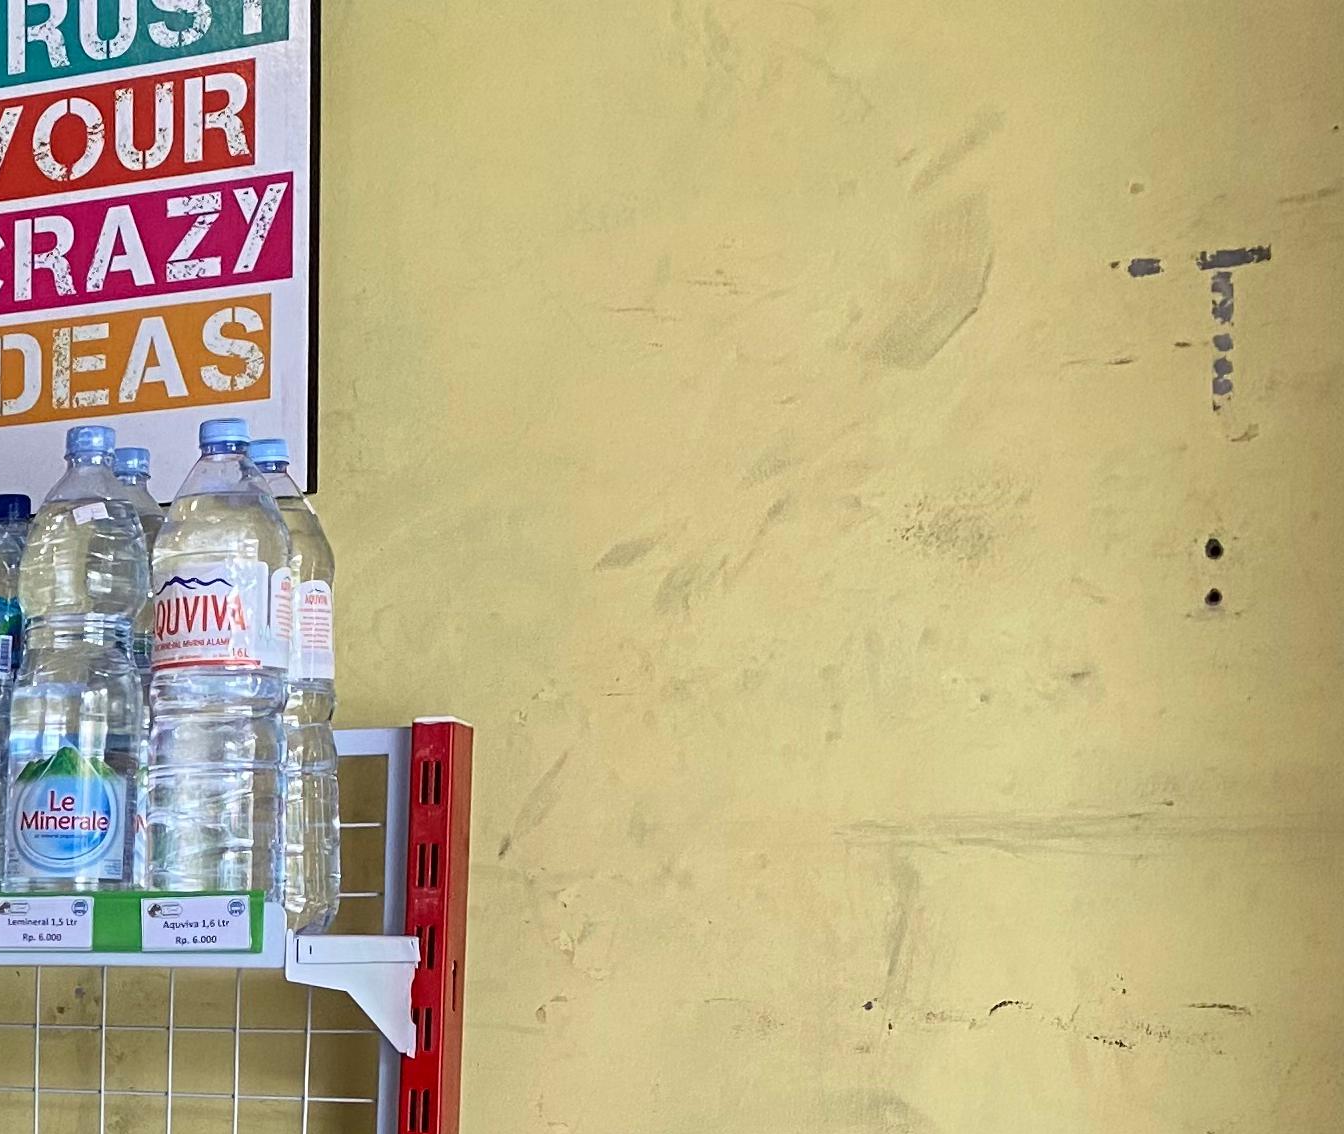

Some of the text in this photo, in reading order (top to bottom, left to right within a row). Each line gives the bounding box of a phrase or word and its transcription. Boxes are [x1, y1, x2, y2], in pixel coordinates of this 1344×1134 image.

[154, 594, 246, 640] QUVIVA
[50, 790, 75, 812] Le
[20, 809, 110, 832] Minerale
[7, 918, 49, 927] Lemineral
[163, 920, 199, 930] Aquviva
[22, 933, 62, 943] Rp. 6.000
[175, 935, 217, 946] Rp. 6.000
